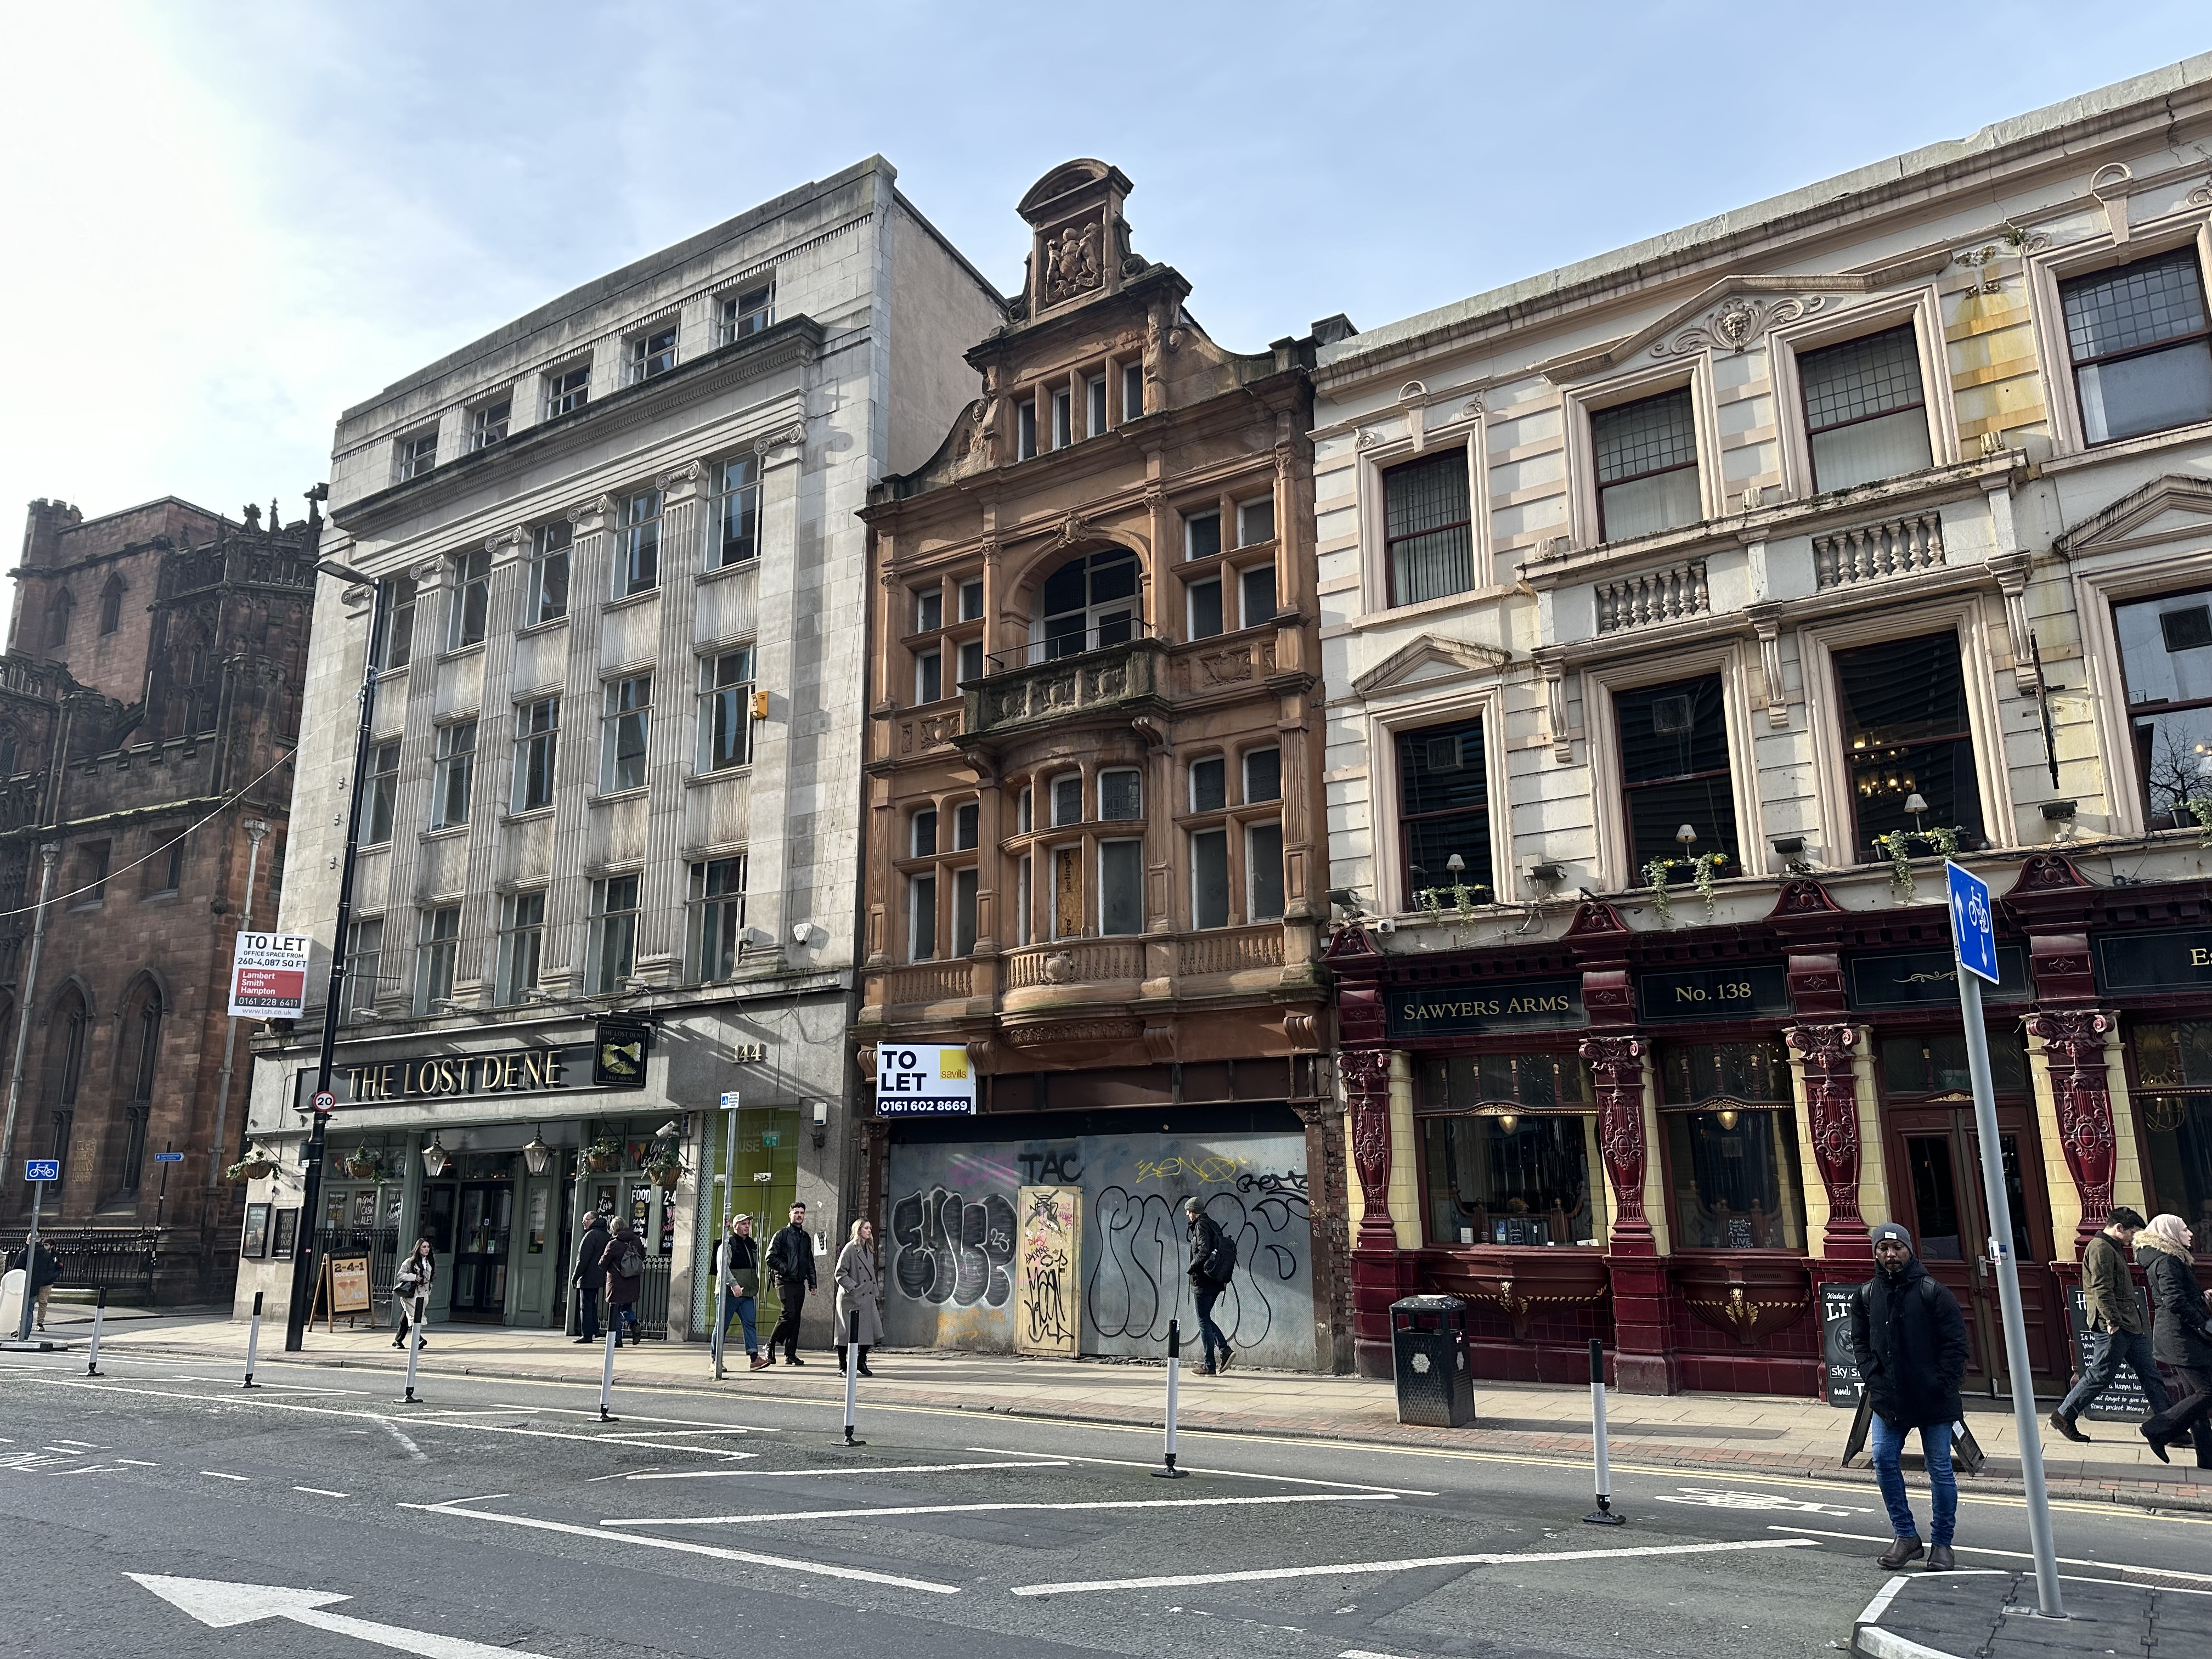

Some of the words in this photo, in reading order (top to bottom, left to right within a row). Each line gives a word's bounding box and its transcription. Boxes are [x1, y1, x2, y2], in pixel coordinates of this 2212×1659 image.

[245, 935, 267, 949] TO
[273, 936, 306, 951] LET
[238, 958, 280, 967] 260-4,087
[242, 971, 275, 980] Lambert
[241, 986, 275, 996] Hampton
[1675, 986, 1712, 1002] No.
[1717, 983, 1751, 999] 138
[239, 997, 257, 1005] 0161
[279, 999, 297, 1007] 6411
[1404, 1000, 1500, 1020] SAWYERS
[1506, 996, 1569, 1013] ARMS
[732, 1042, 762, 1063] 144
[882, 1051, 917, 1069] TO
[347, 1065, 395, 1098] THE
[404, 1057, 475, 1094] LOST
[482, 1050, 563, 1089] DENE
[941, 1069, 967, 1078] savills
[881, 1073, 927, 1091] LET
[318, 1097, 332, 1106] 20
[881, 1101, 907, 1111] 0161
[910, 1101, 934, 1111] 602
[936, 1101, 968, 1111] 8669
[1018, 1153, 1084, 1183] TAC
[631, 1189, 651, 1204] FOOD
[361, 1206, 374, 1215] CASK
[360, 1216, 373, 1225] ALES
[1731, 1237, 1751, 1245] LIVE
[334, 1262, 365, 1273] 2-4-1
[1831, 1364, 1848, 1379] sky
[1834, 1385, 1851, 1396] and
[2114, 1381, 2131, 1391] happy
[2104, 1395, 2120, 1403] forget
[2126, 1405, 2145, 1414] money
